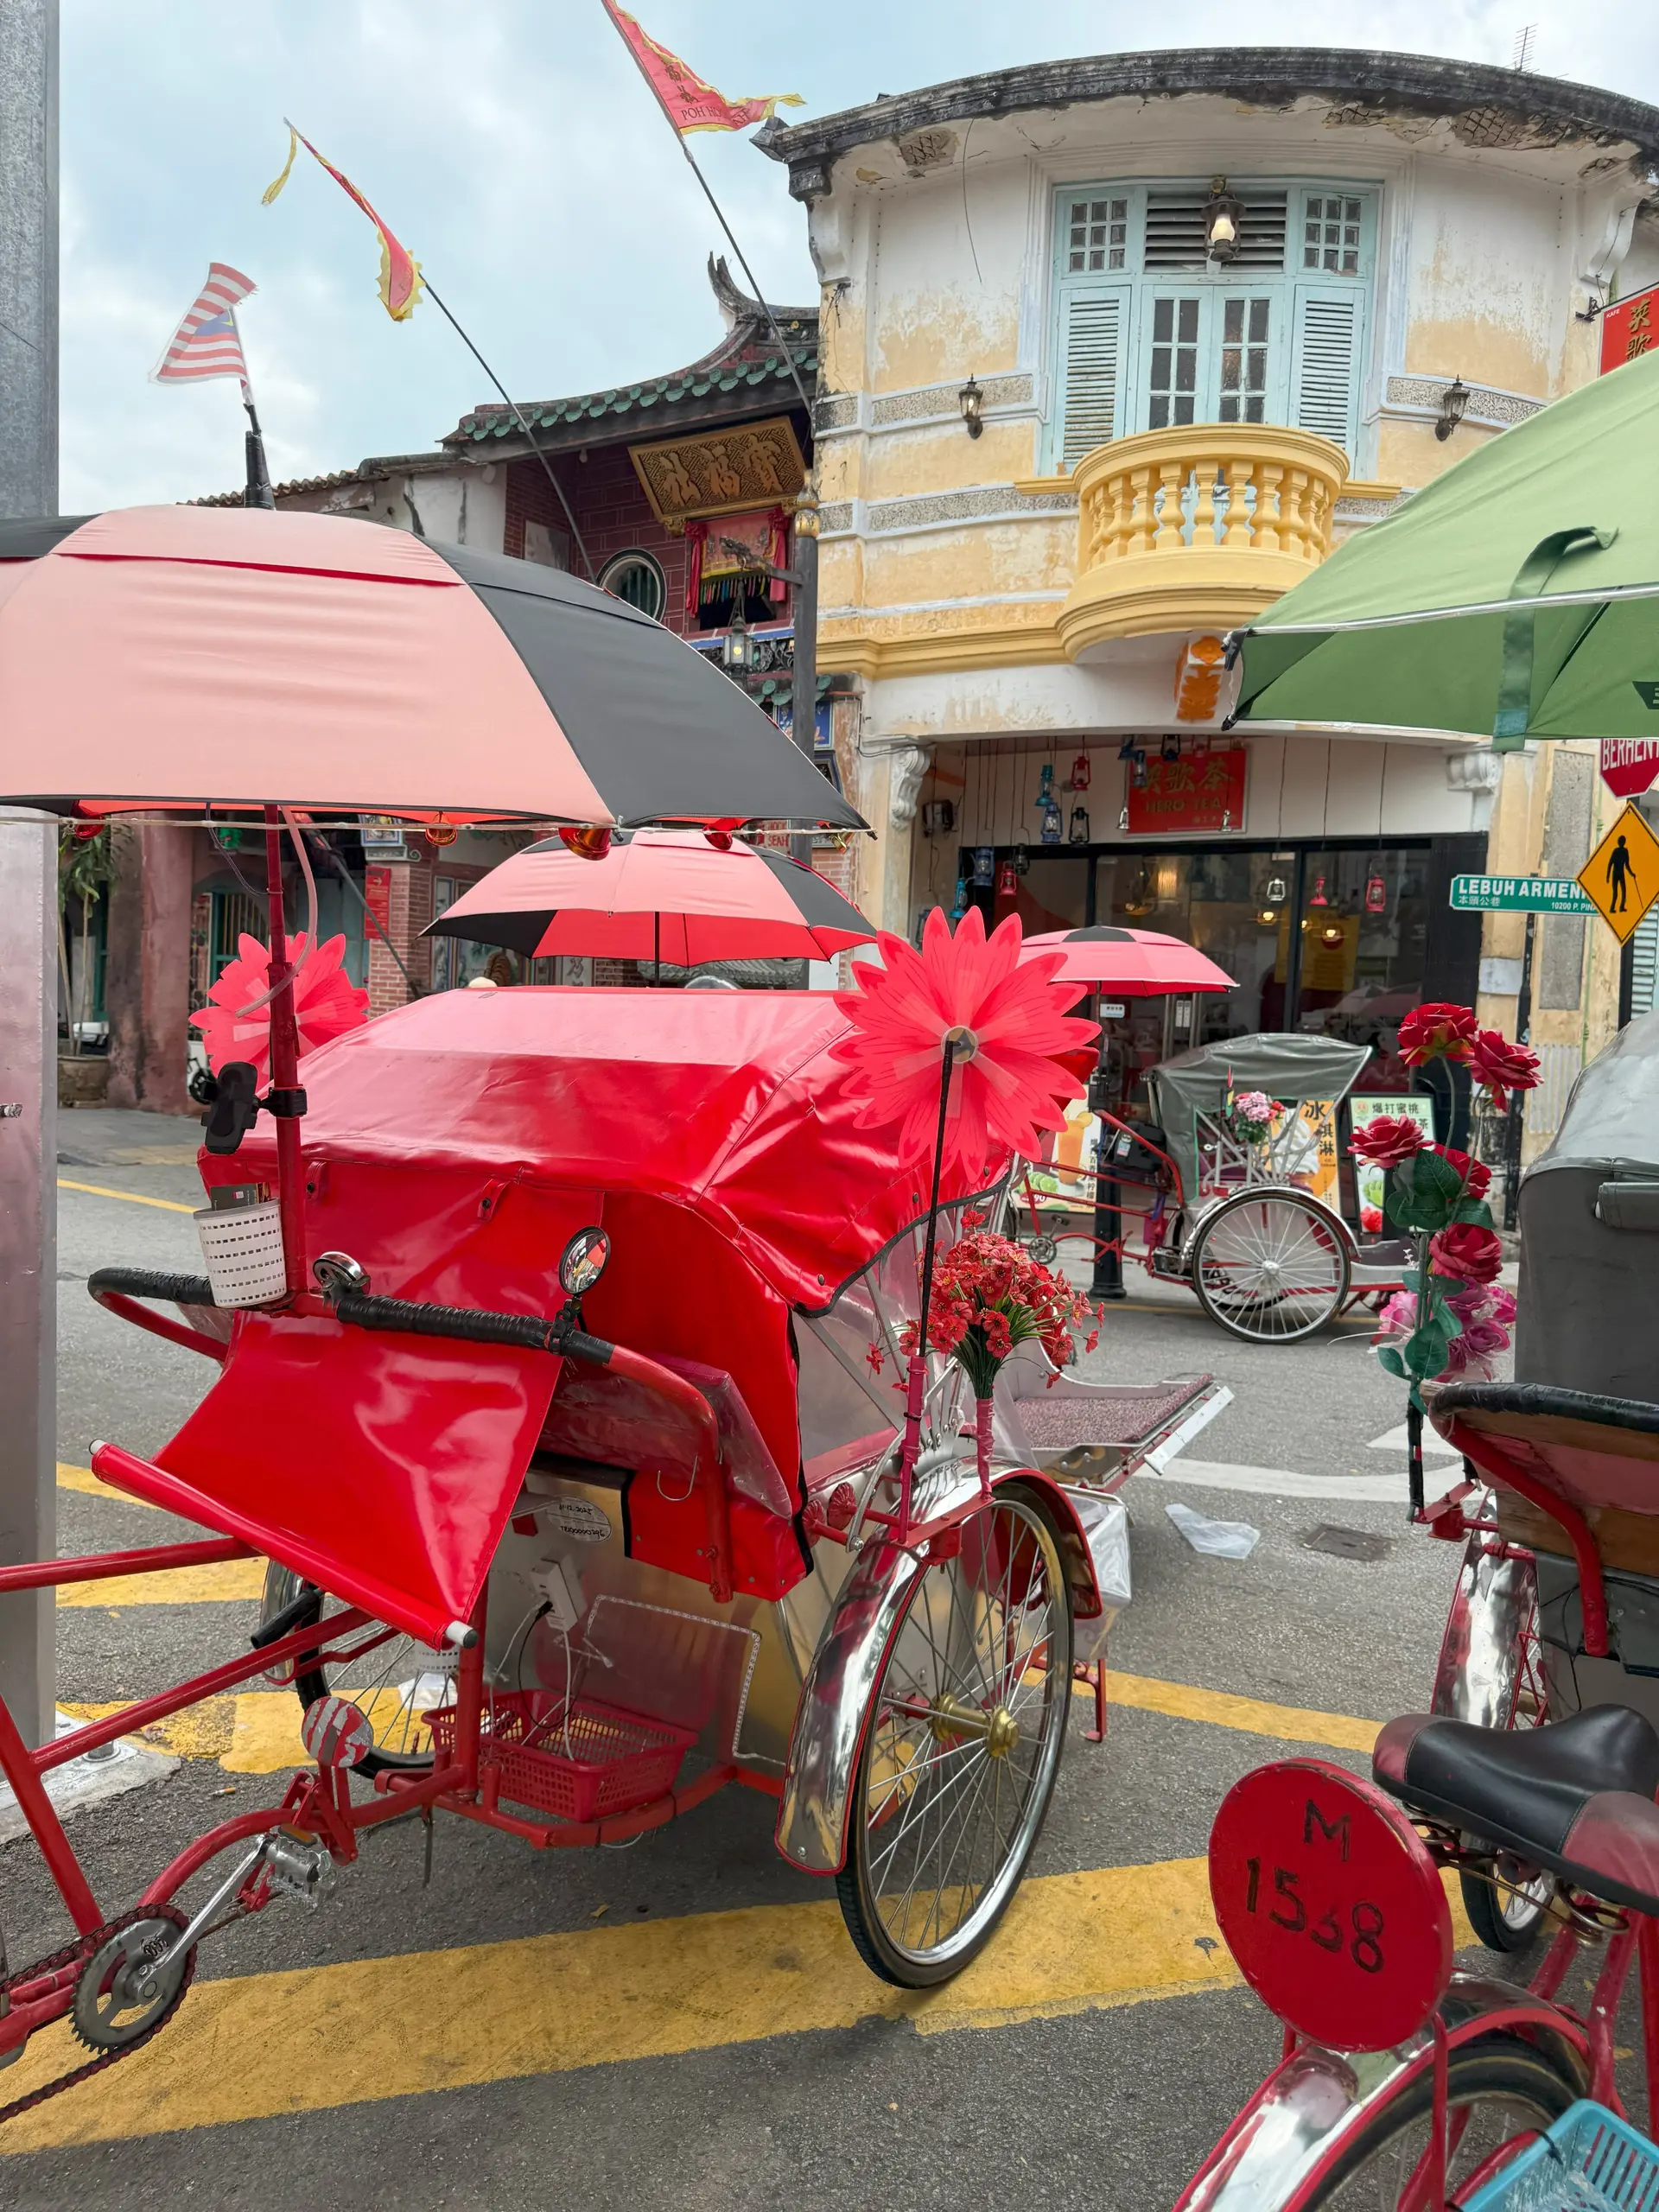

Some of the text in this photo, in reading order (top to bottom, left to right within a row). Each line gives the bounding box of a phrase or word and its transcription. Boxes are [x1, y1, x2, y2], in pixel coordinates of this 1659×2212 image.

[681, 106, 705, 121] POH
[1145, 796, 1221, 813] HERO TEA
[1459, 879, 1515, 896] LEBUH
[1458, 896, 1501, 907] 本頭公巷
[1551, 901, 1572, 911] 10200
[1573, 903, 1580, 912] P.
[1303, 1798, 1351, 1862] M
